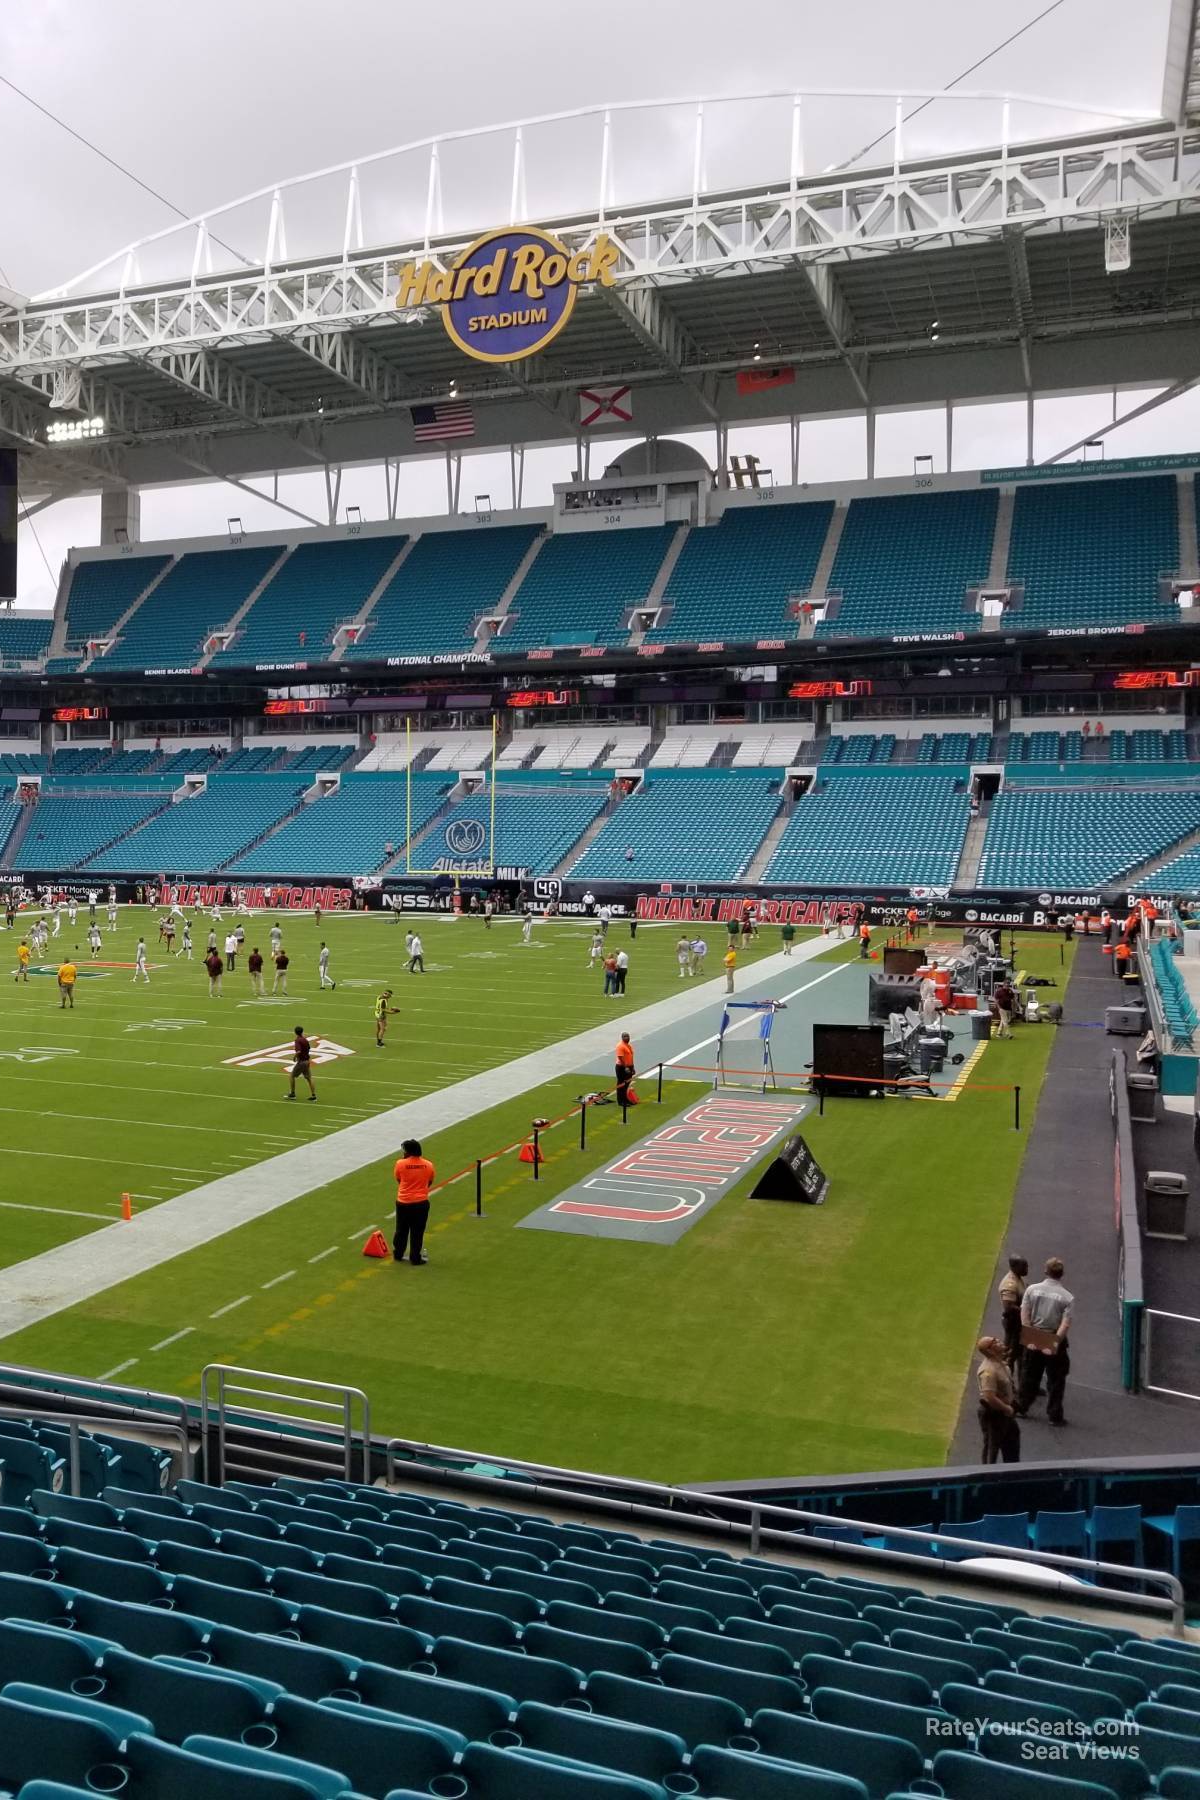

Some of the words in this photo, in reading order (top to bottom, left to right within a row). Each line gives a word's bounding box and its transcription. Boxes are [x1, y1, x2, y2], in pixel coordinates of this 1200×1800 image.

[396, 248, 506, 308] Hard
[511, 234, 620, 299] Rock
[468, 307, 548, 333] STADIUM
[604, 515, 621, 525] 304
[1047, 628, 1086, 637] JEROME
[1087, 626, 1125, 636] BROWN
[893, 635, 920, 643] STEVE
[921, 633, 955, 642] WALSH
[387, 656, 432, 667] NATIONAL
[433, 653, 492, 665] CHAMPIONS
[276, 663, 294, 671] DUNN
[431, 856, 491, 873] Allstate
[497, 867, 527, 880] MILK
[37, 885, 69, 894] ROCKET
[69, 885, 104, 896] Mortgage
[1054, 894, 1102, 906] BACARDÍ
[559, 902, 628, 915] INSUANCE.
[871, 906, 908, 916] ROCKET
[980, 911, 1025, 923] BACARDÍ
